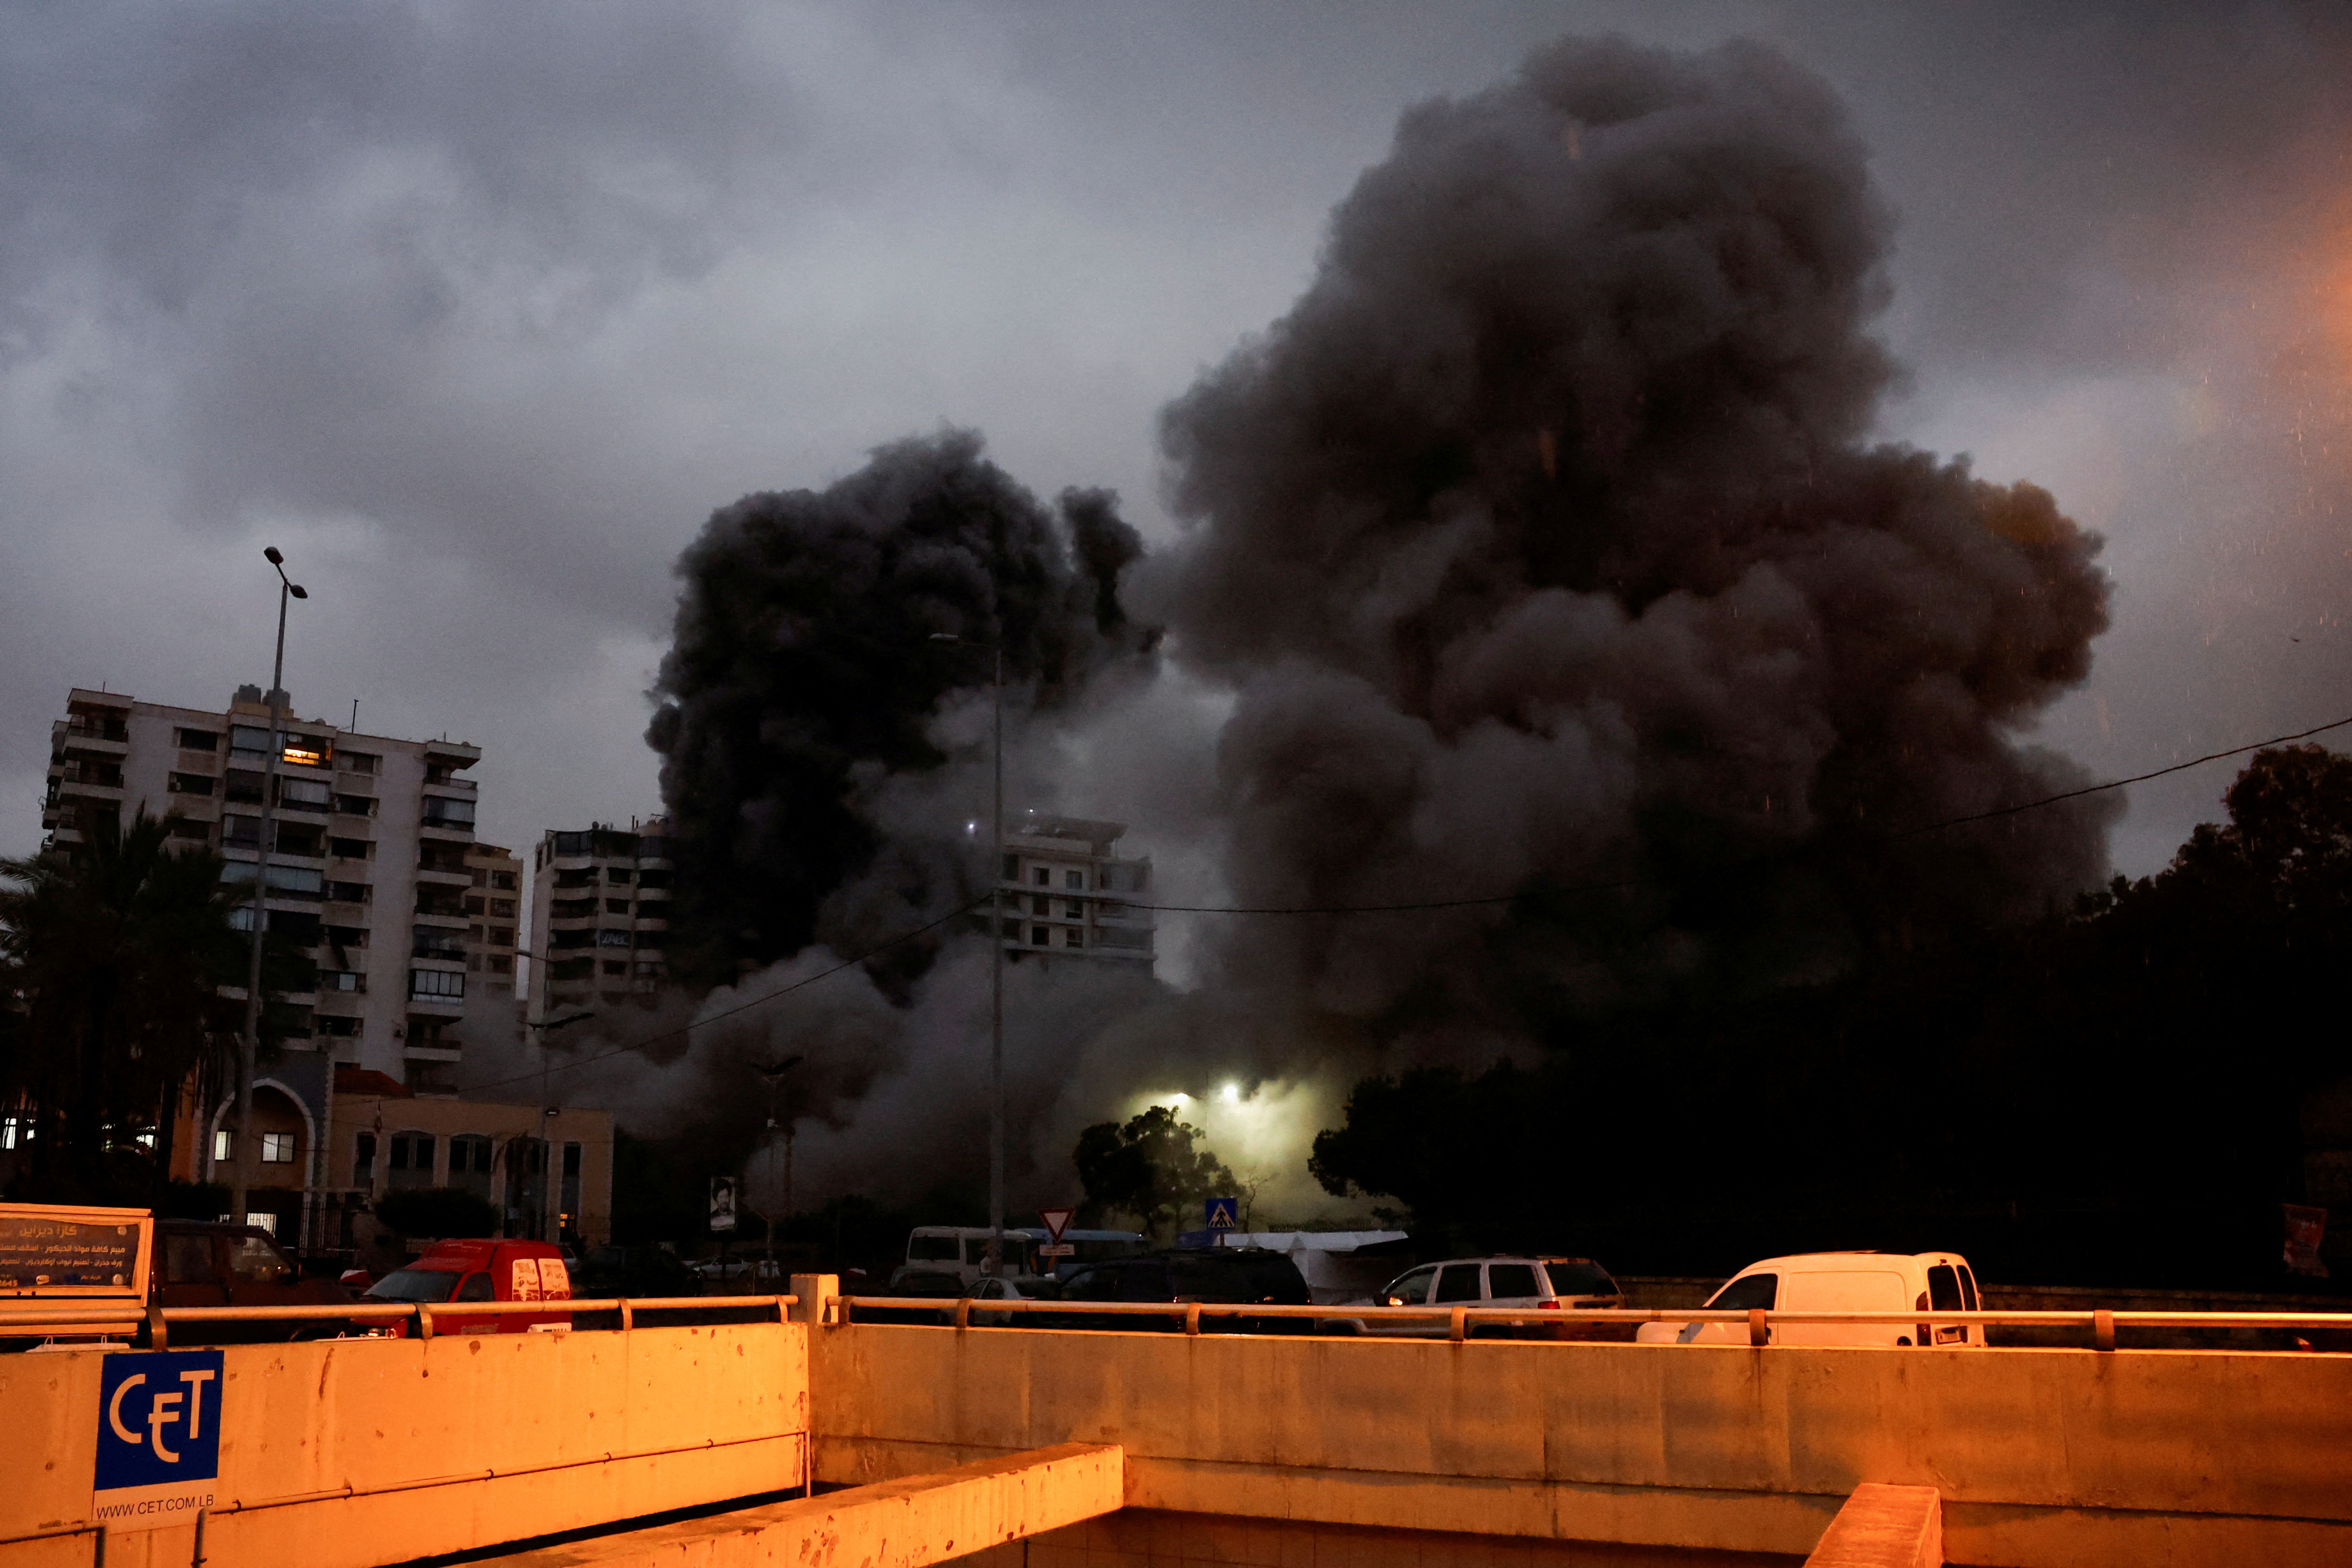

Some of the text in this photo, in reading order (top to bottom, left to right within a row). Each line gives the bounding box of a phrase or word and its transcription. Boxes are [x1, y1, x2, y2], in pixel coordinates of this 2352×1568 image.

[74, 1245, 90, 1254] مواد
[109, 1369, 215, 1463] CET
[97, 1494, 214, 1519] WWW.CET.COM.LB
